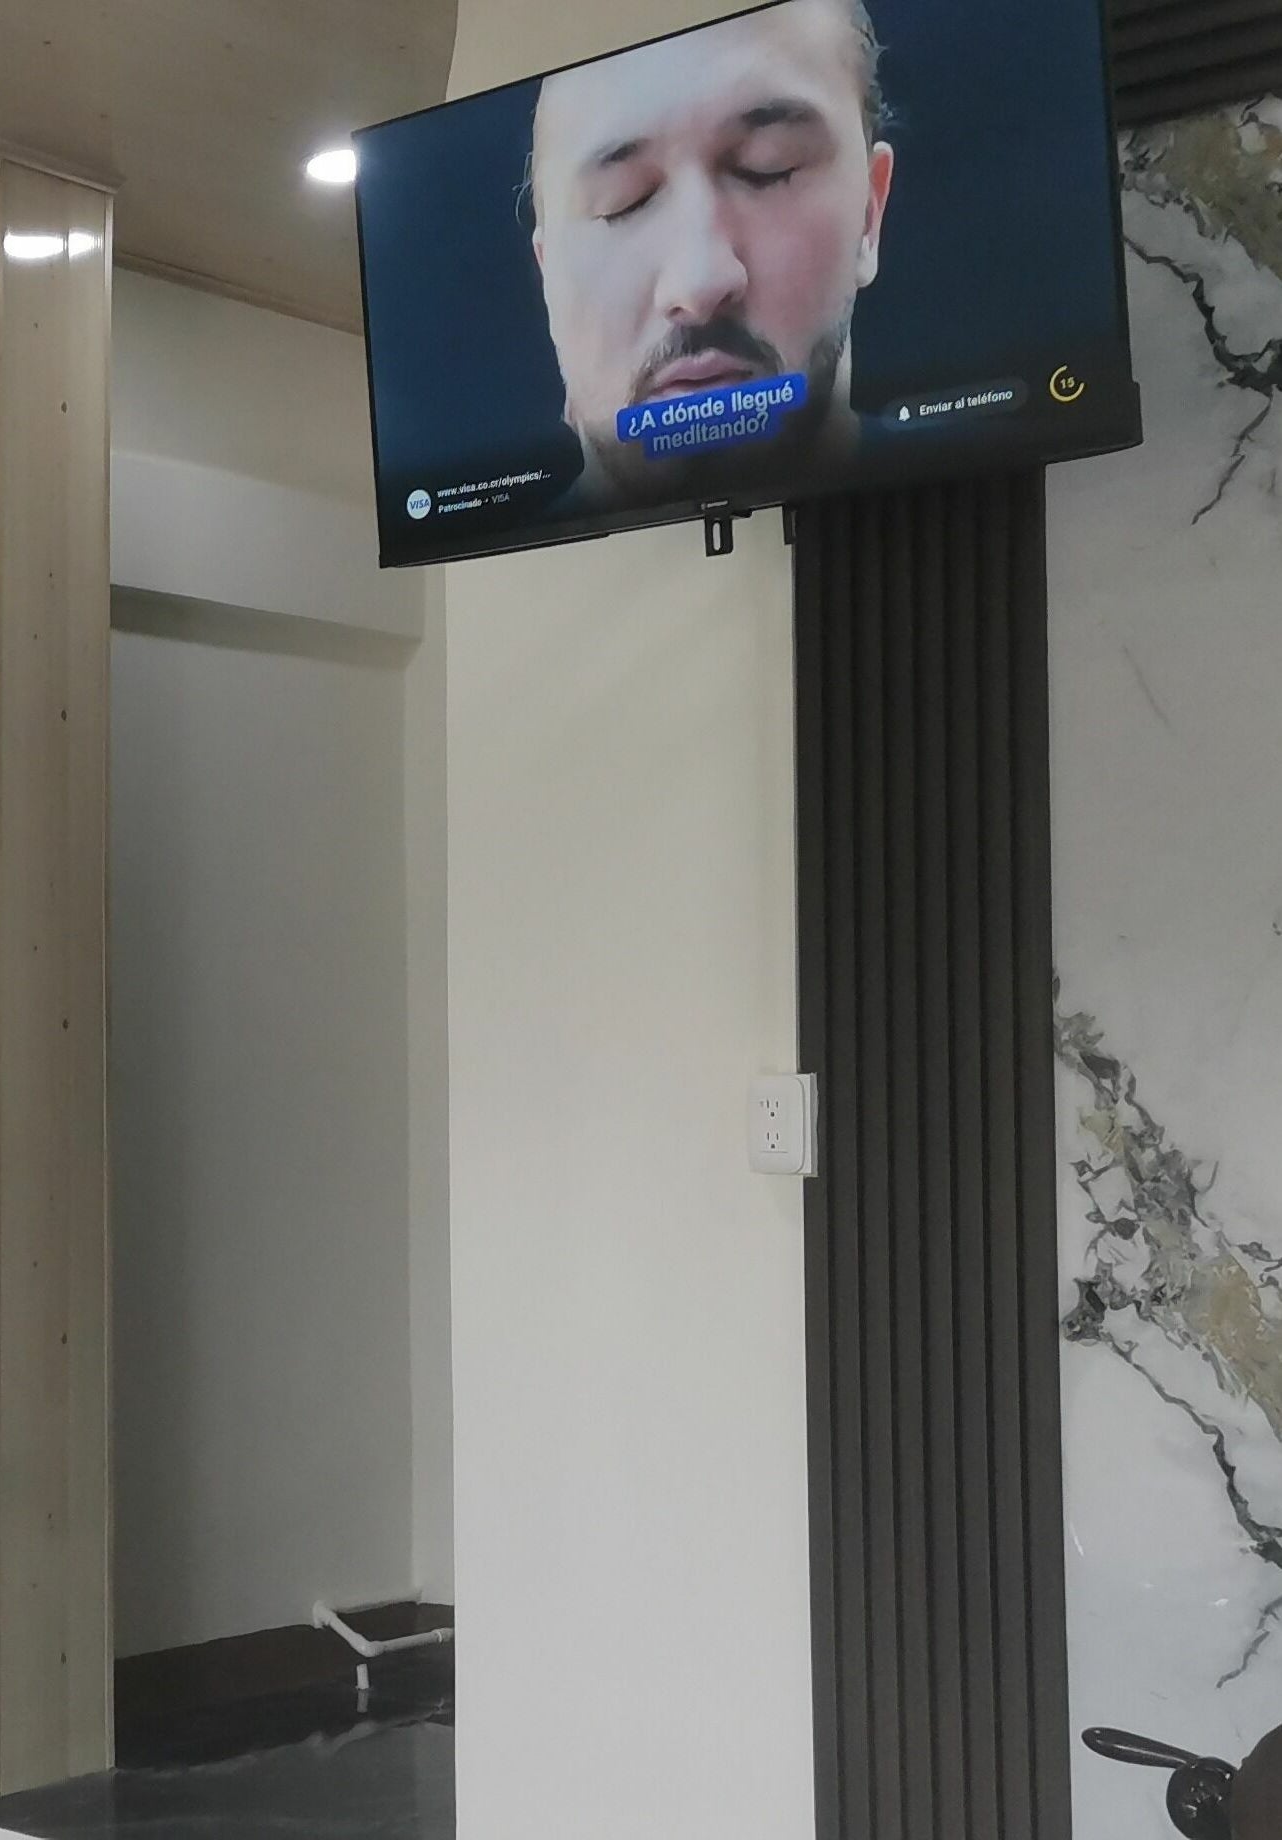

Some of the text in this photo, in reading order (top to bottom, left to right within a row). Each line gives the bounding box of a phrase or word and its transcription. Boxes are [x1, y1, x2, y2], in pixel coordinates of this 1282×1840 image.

[628, 380, 794, 437] ¿A dónde llegué
[919, 389, 1013, 416] Enviar al teléfono
[653, 411, 769, 451] meditando?
[408, 498, 430, 510] VISA
[438, 492, 510, 514] Patrocinado VISA
